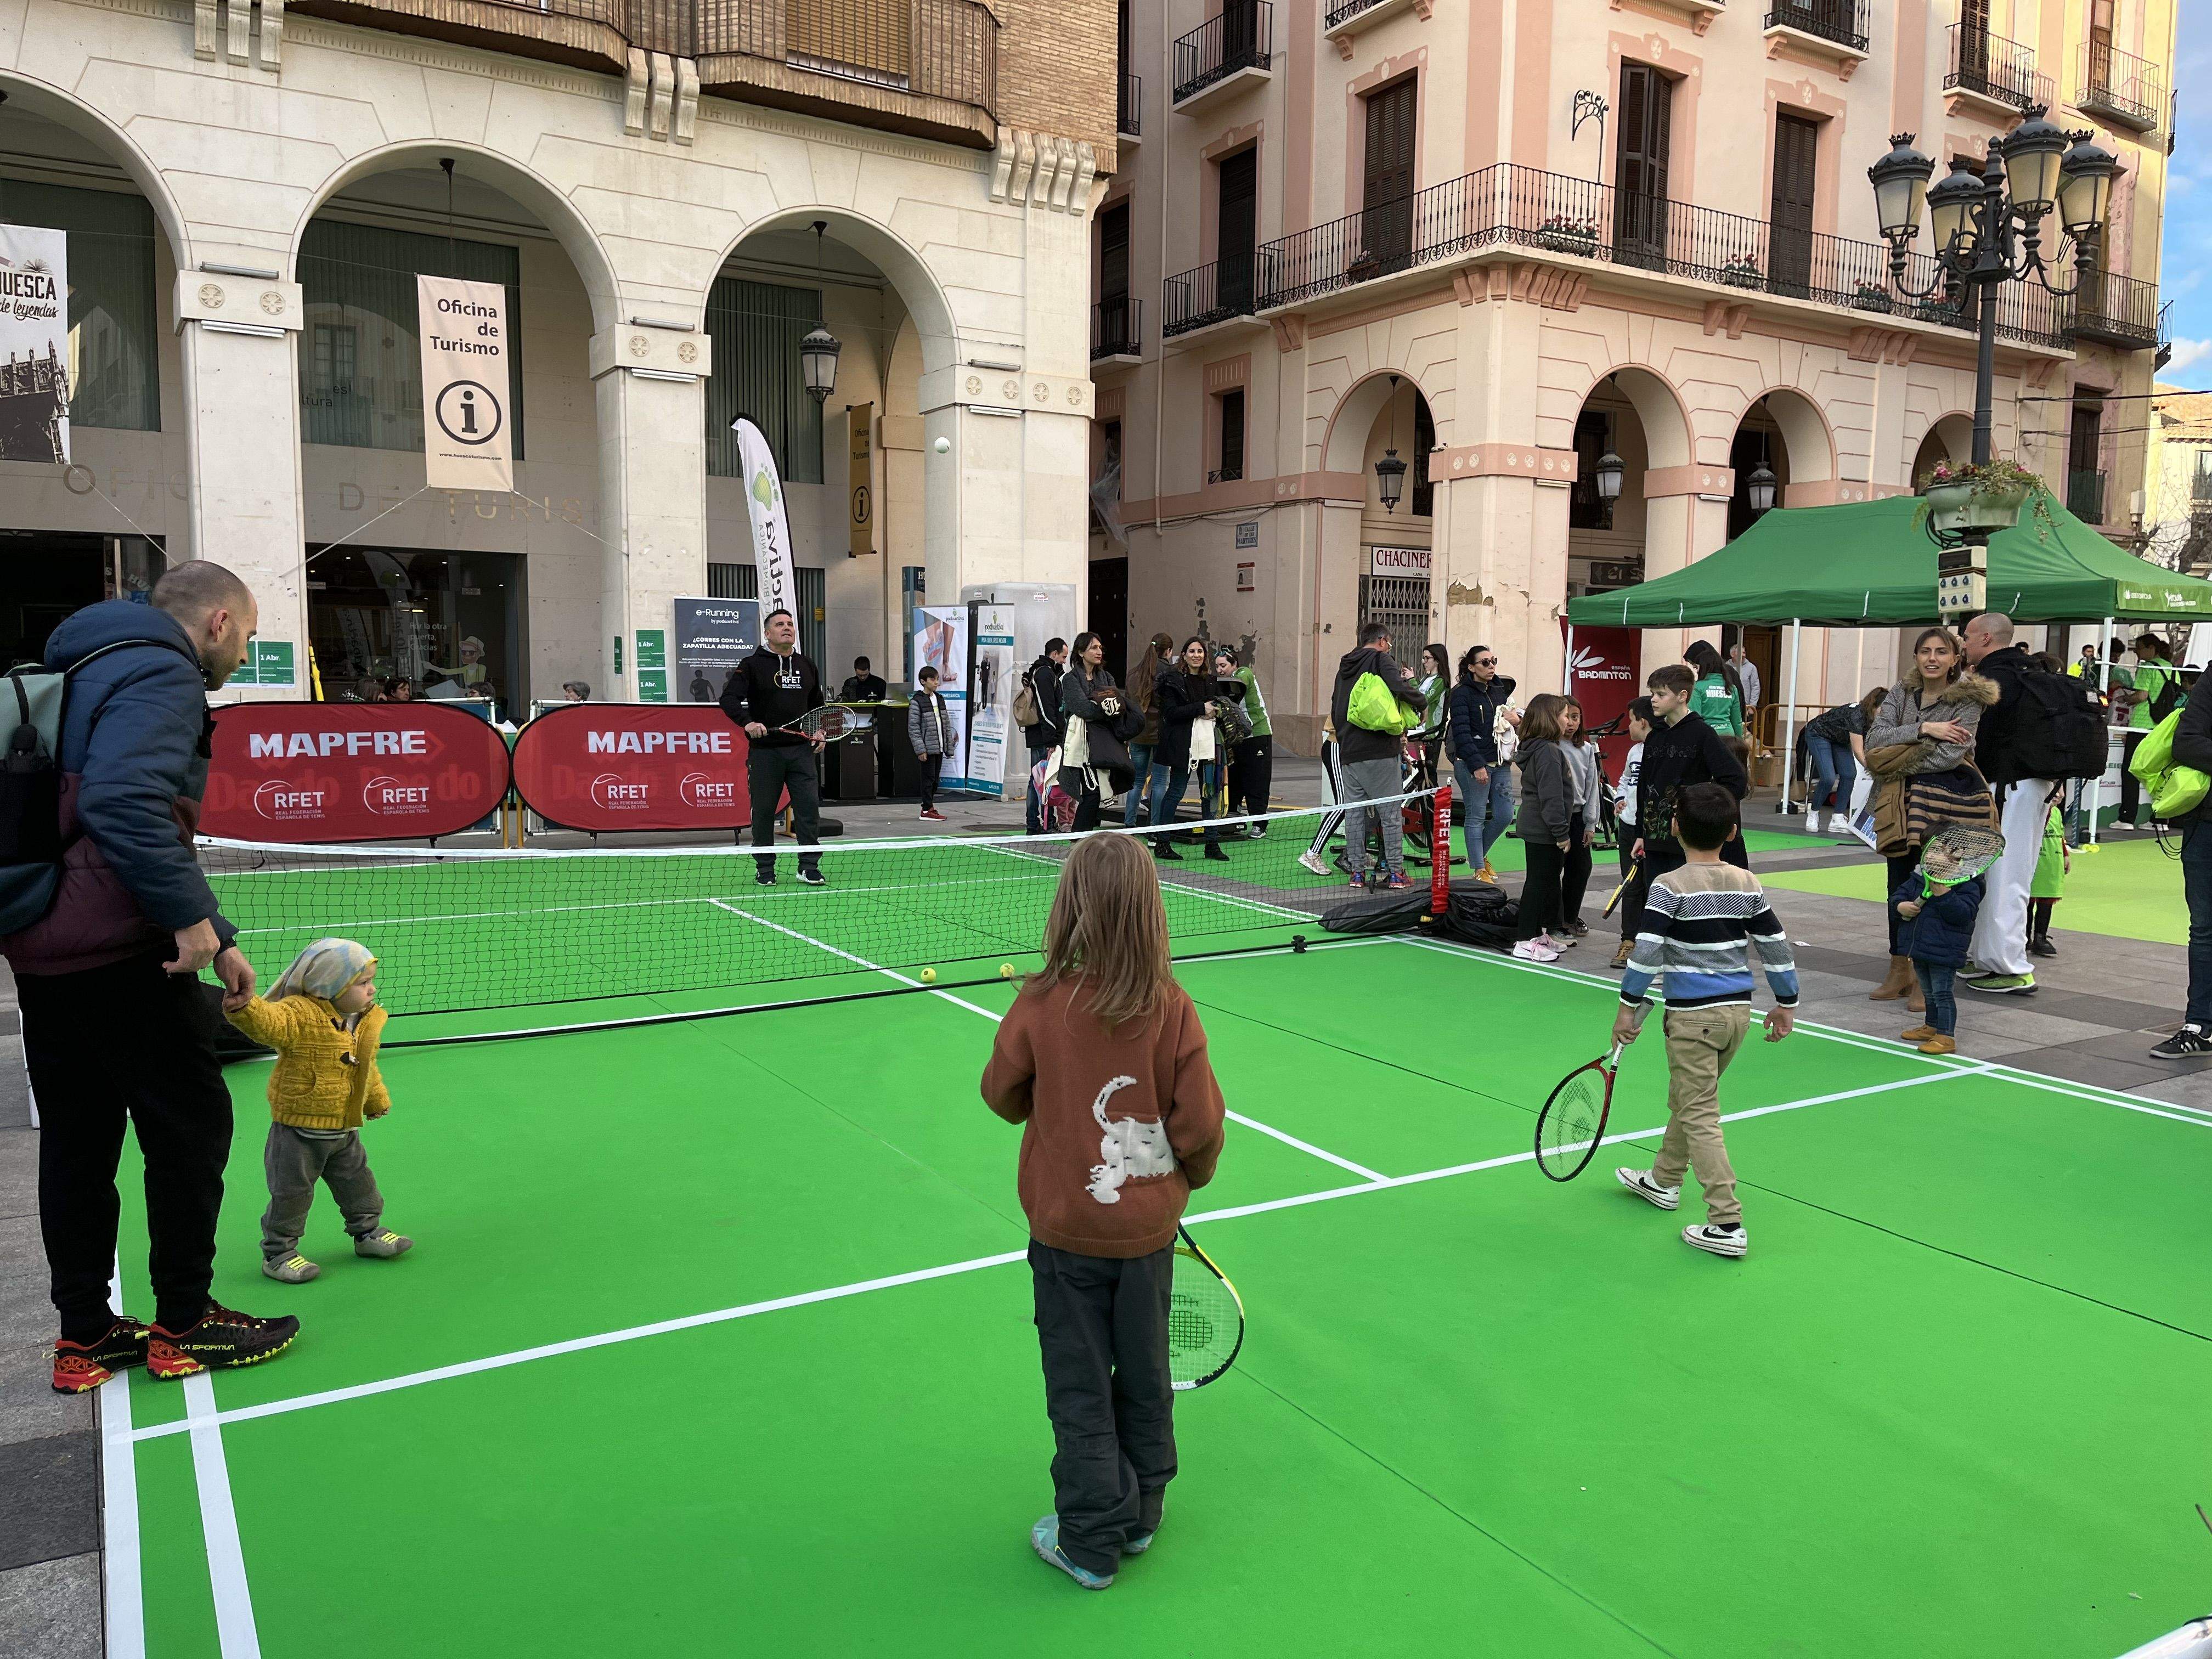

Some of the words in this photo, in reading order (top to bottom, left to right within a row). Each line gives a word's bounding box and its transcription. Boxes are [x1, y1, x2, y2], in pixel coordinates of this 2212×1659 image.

[0, 271, 57, 300] UESCA
[13, 299, 59, 321] leyendas
[437, 298, 497, 318] Oficina
[477, 321, 498, 337] de
[430, 335, 499, 356] Turismo
[855, 428, 869, 438] Oficina
[696, 608, 739, 619] e-Running
[1578, 670, 1632, 680] BADMINTON
[250, 731, 426, 758] MAPFRE
[588, 731, 731, 753] MAPFRE
[382, 787, 429, 803] RFET
[608, 785, 648, 799] RFET
[696, 783, 734, 797] RFET
[275, 792, 324, 808] RFET
[1439, 808, 1451, 846] RFET
